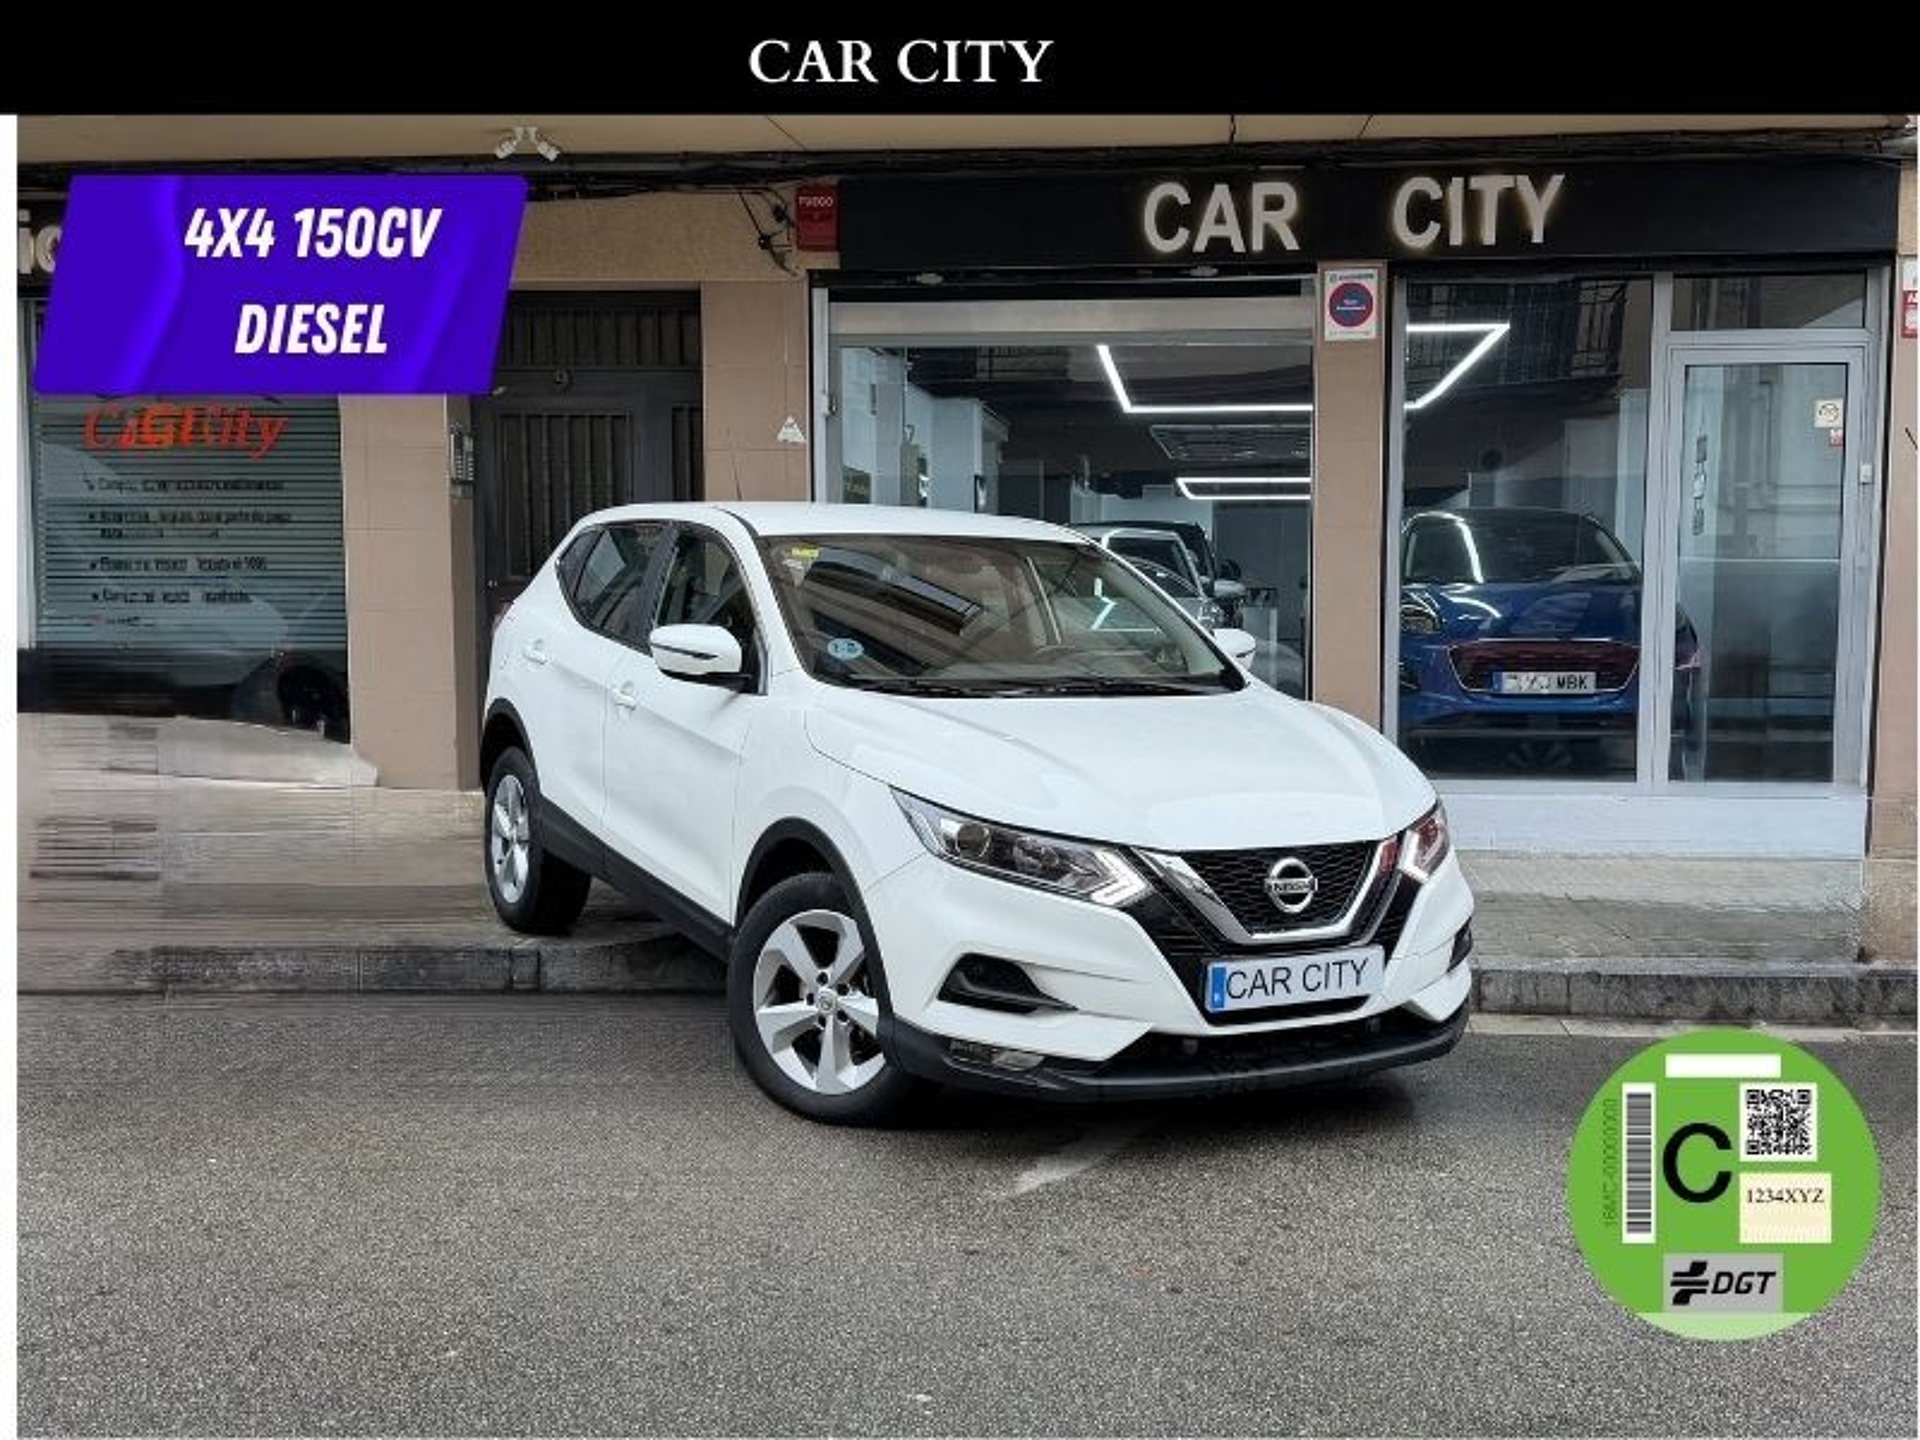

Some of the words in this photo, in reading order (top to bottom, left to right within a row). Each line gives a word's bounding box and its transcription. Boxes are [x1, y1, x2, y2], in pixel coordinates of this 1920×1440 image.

[1142, 181, 1300, 254] CAR
[1393, 174, 1565, 249] CITY
[1226, 966, 1292, 1000] CAR
[1302, 958, 1369, 993] CITY
